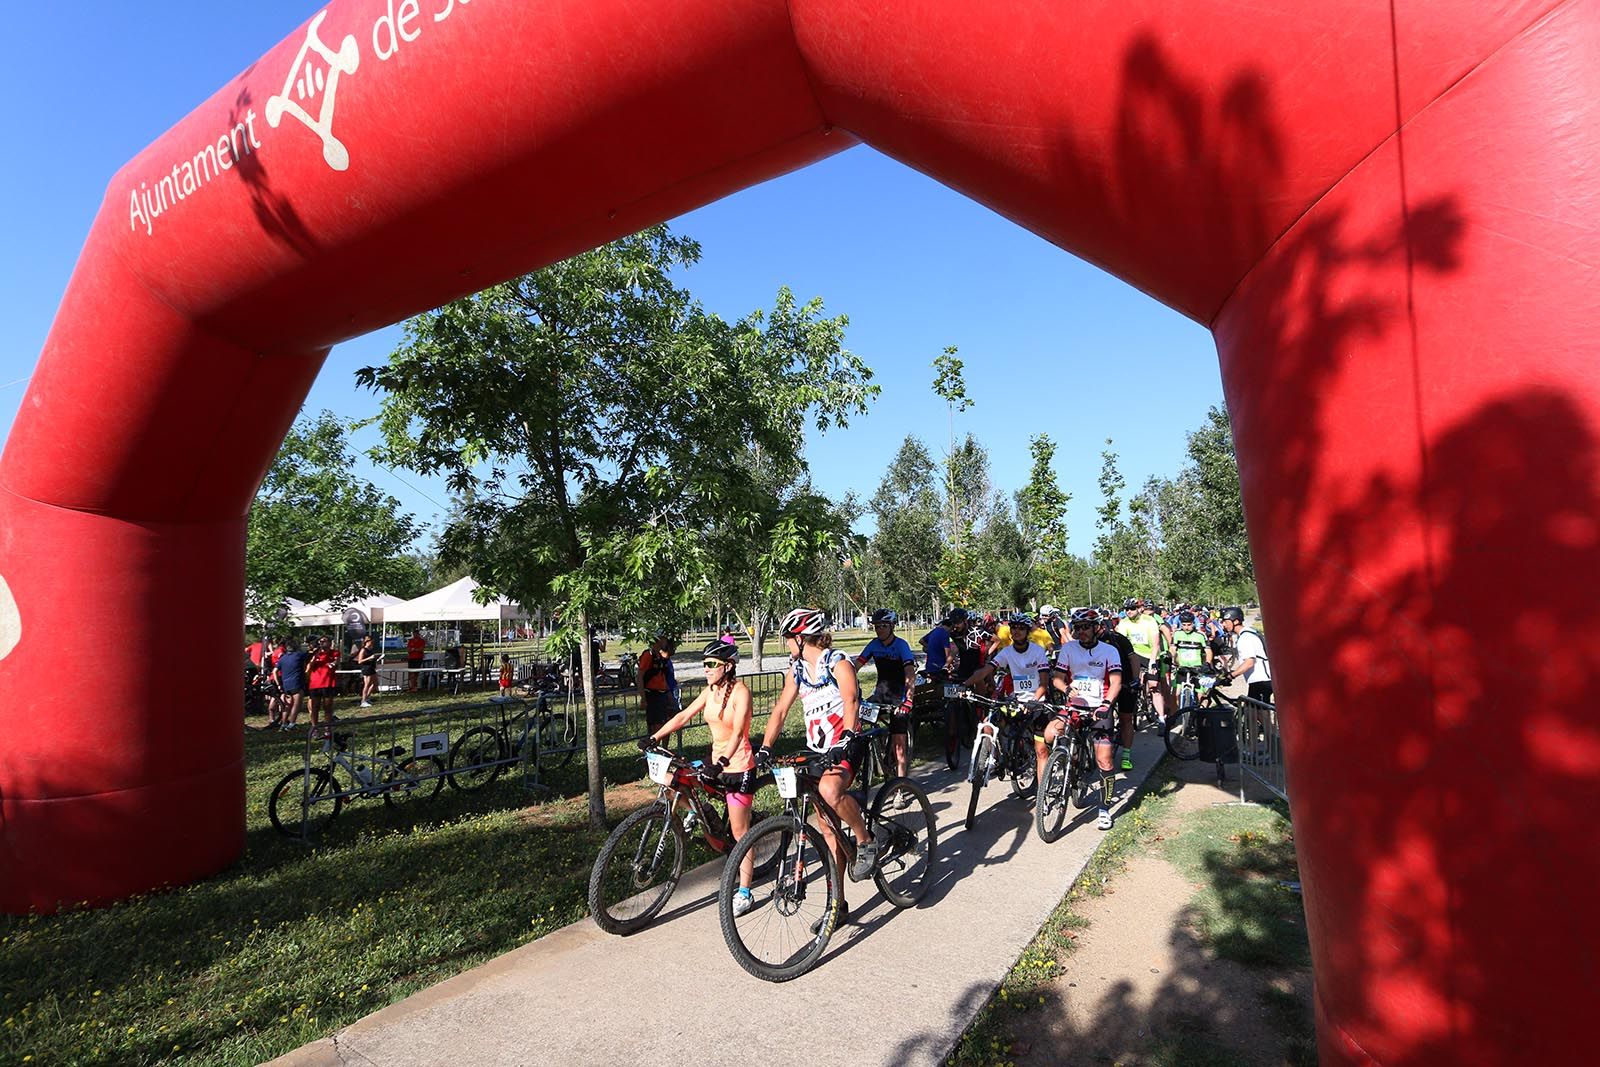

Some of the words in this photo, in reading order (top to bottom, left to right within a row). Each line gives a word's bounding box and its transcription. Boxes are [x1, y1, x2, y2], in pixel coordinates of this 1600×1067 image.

[129, 109, 261, 236] Ajuntament
[372, 0, 422, 60] de
[1019, 680, 1032, 690] 039
[1078, 681, 1091, 691] 032
